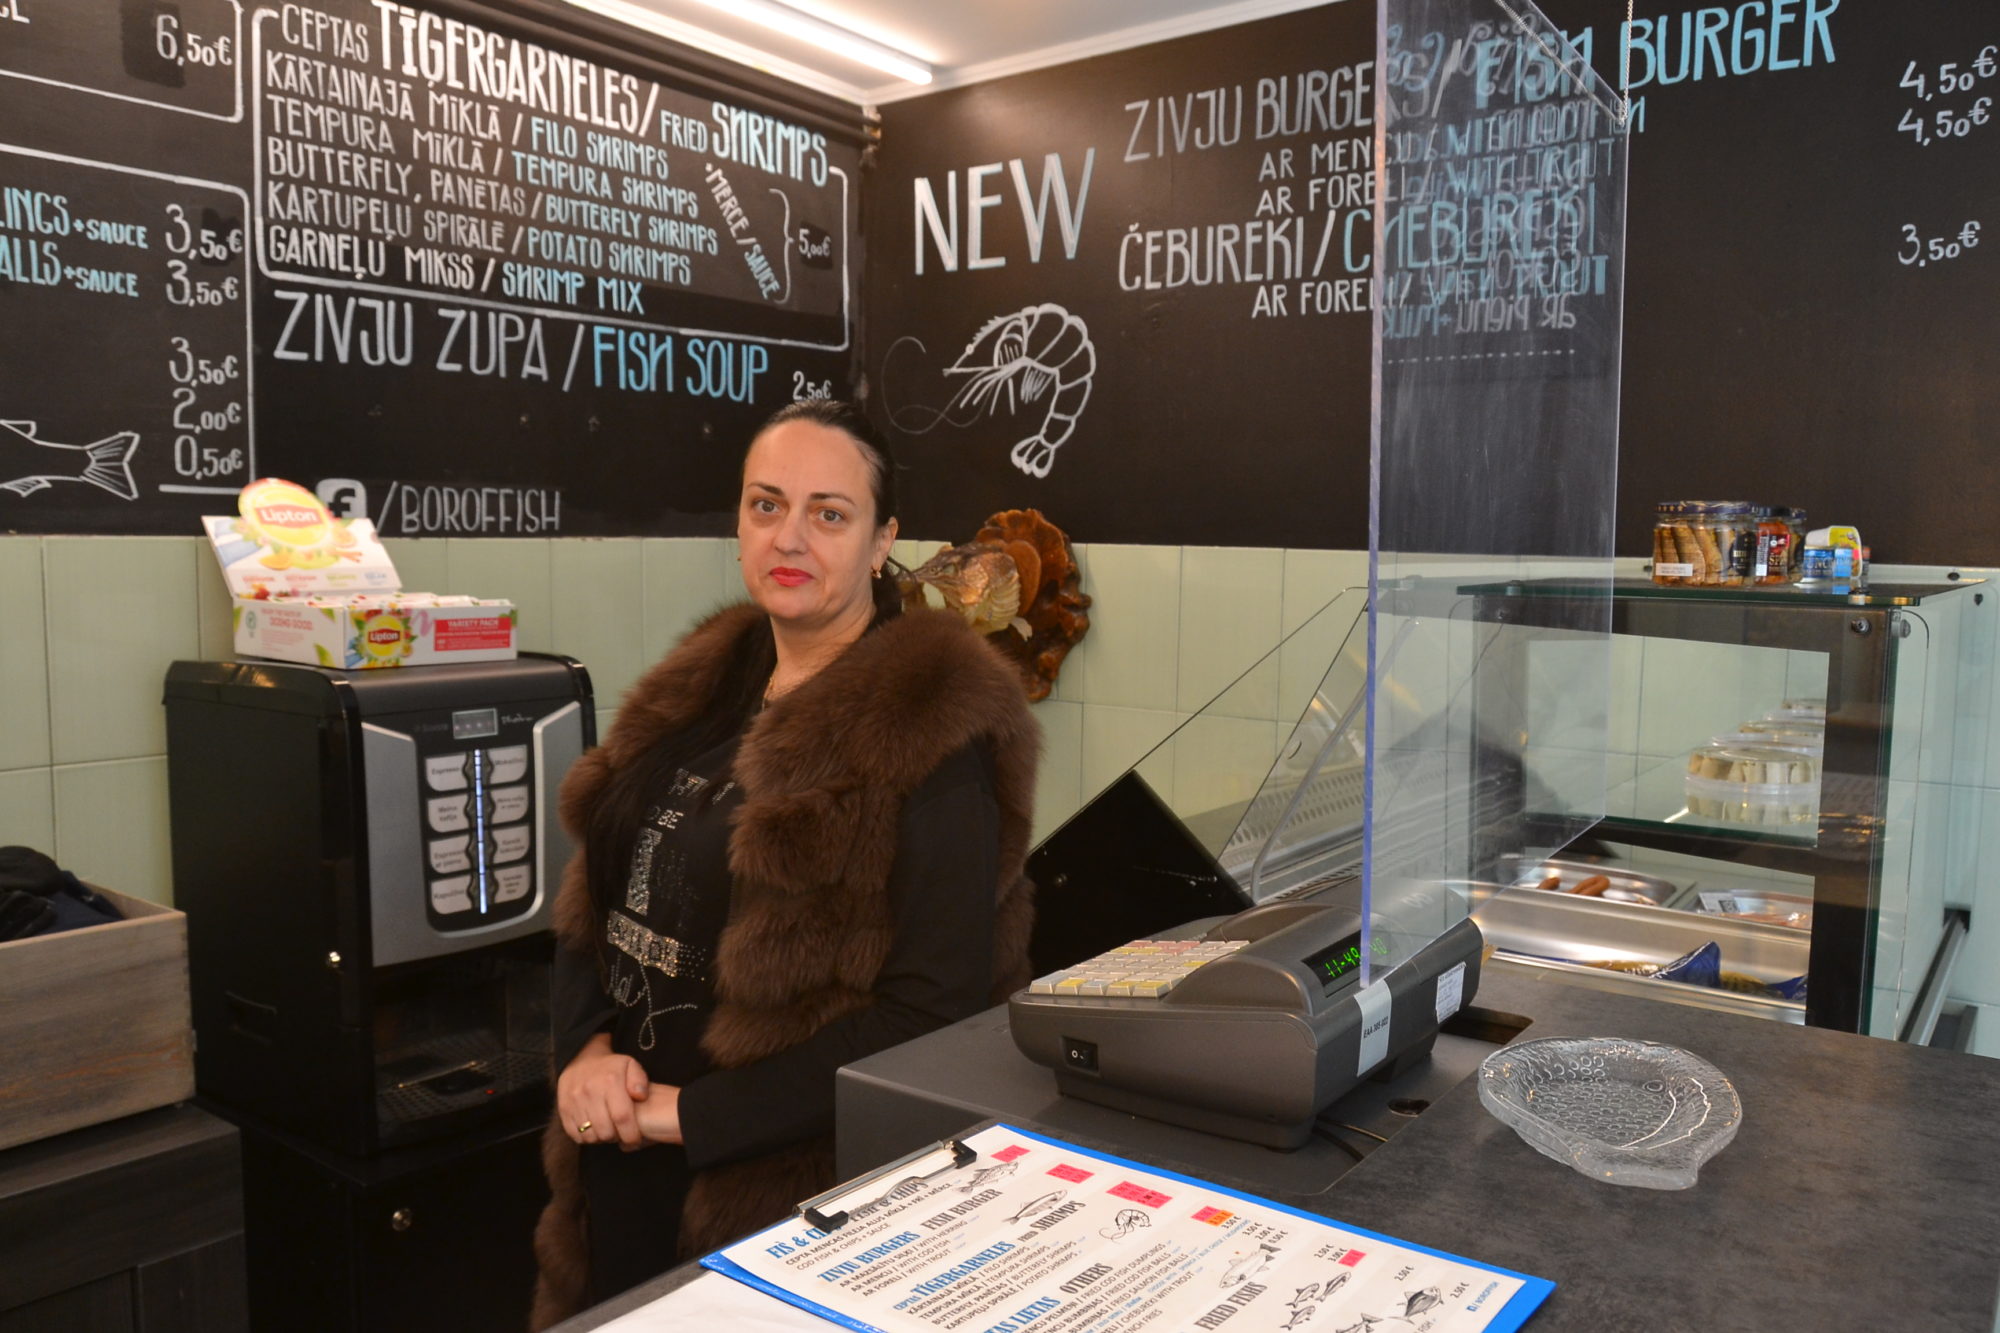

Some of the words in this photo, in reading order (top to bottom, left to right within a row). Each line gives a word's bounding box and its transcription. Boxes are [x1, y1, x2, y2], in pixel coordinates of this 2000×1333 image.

[281, 3, 370, 64] CEPTAS
[660, 109, 708, 153] FRIED
[712, 101, 828, 188] SHRIMPS
[1123, 85, 1243, 164] ZIVJU
[1618, 0, 1840, 91] BURGER
[266, 94, 396, 154] TEMPURA
[512, 151, 613, 199] TEMPURA
[622, 179, 699, 219] SHRIMPS
[531, 117, 578, 159] FILO
[586, 131, 669, 181] SHRIMPS
[1258, 148, 1295, 183] AR
[0, 186, 70, 236] INGS
[546, 194, 643, 242] BUTTERFLY
[648, 215, 719, 257] SHRIMPS
[913, 147, 1096, 276] NEW
[1255, 185, 1295, 218] AR
[527, 226, 603, 268] POTATO
[608, 243, 692, 287] SHRIMPS
[744, 243, 780, 300] SAUCE
[1117, 215, 1306, 293] ČEBUREKI
[404, 246, 476, 291] MIKSS
[501, 261, 586, 305] SHRIMP
[597, 277, 646, 316] MIX
[1250, 284, 1288, 319] AR
[273, 289, 414, 367] ZIVJU
[436, 307, 549, 382] ZUPA
[593, 325, 674, 393] FISH
[686, 338, 769, 404] SOUP
[260, 507, 318, 527] Lipton
[369, 629, 400, 643] Lipton
[885, 1179, 929, 1201] CHIPS
[1031, 1201, 1086, 1231] SHRIMPS
[786, 1252, 813, 1266] CEPTA
[810, 1236, 845, 1254] MENCAS
[866, 1216, 886, 1228] ALUS
[796, 1260, 816, 1271] COD
[814, 1251, 833, 1262] FISH
[839, 1237, 863, 1250] CHIPS
[866, 1222, 892, 1237] SAUCE
[817, 1261, 861, 1283] ZIVJU
[855, 1232, 920, 1264] BURGERS
[921, 1213, 957, 1231] FISH
[949, 1189, 1003, 1216] BURGER
[839, 1280, 853, 1288] AR
[917, 1236, 939, 1248] WITH
[936, 1220, 968, 1238] HERRING
[983, 1263, 1001, 1274] FILO
[999, 1246, 1031, 1265] SHRIMPS
[1011, 1257, 1048, 1281] BUTTERFLY
[1046, 1241, 1077, 1260] SHRIMPS
[851, 1284, 865, 1293] AR
[862, 1270, 894, 1286] MENCU
[897, 1256, 920, 1269] WITH
[917, 1248, 935, 1259] COD
[933, 1239, 952, 1251] FISH
[862, 1289, 877, 1297] AR
[906, 1262, 929, 1275] WITH
[925, 1249, 952, 1264] TROUT
[919, 1299, 960, 1320] TEMPURA
[986, 1263, 1022, 1284] TEMPURA
[1019, 1245, 1051, 1265] SHRIMPS
[1021, 1269, 1049, 1287] POTATO
[1047, 1252, 1078, 1271] SHRIMPS
[1080, 1286, 1103, 1300] FRIED
[1100, 1276, 1117, 1288] COD
[1114, 1266, 1132, 1278] FISH
[1128, 1243, 1166, 1269] DUMPLINGS
[1105, 1283, 1127, 1298] FRIED
[1123, 1273, 1141, 1285] COD
[1137, 1264, 1155, 1276] FISH
[1151, 1252, 1172, 1267] BALLS
[1110, 1293, 1132, 1308] FRIED
[1128, 1274, 1159, 1295] SALMON
[1154, 1265, 1172, 1277] FISH
[1168, 1253, 1189, 1268] BALLS
[1010, 1297, 1061, 1325] LIETAS
[1060, 1263, 1113, 1294] OTHERS
[1121, 1298, 1159, 1324] CHEBUREKI
[1154, 1286, 1176, 1300] WITH
[1171, 1271, 1195, 1288] TROUT
[1142, 1309, 1164, 1323] FRIES
[1195, 1304, 1238, 1331] FRIED
[1227, 1282, 1268, 1307] FISHS
